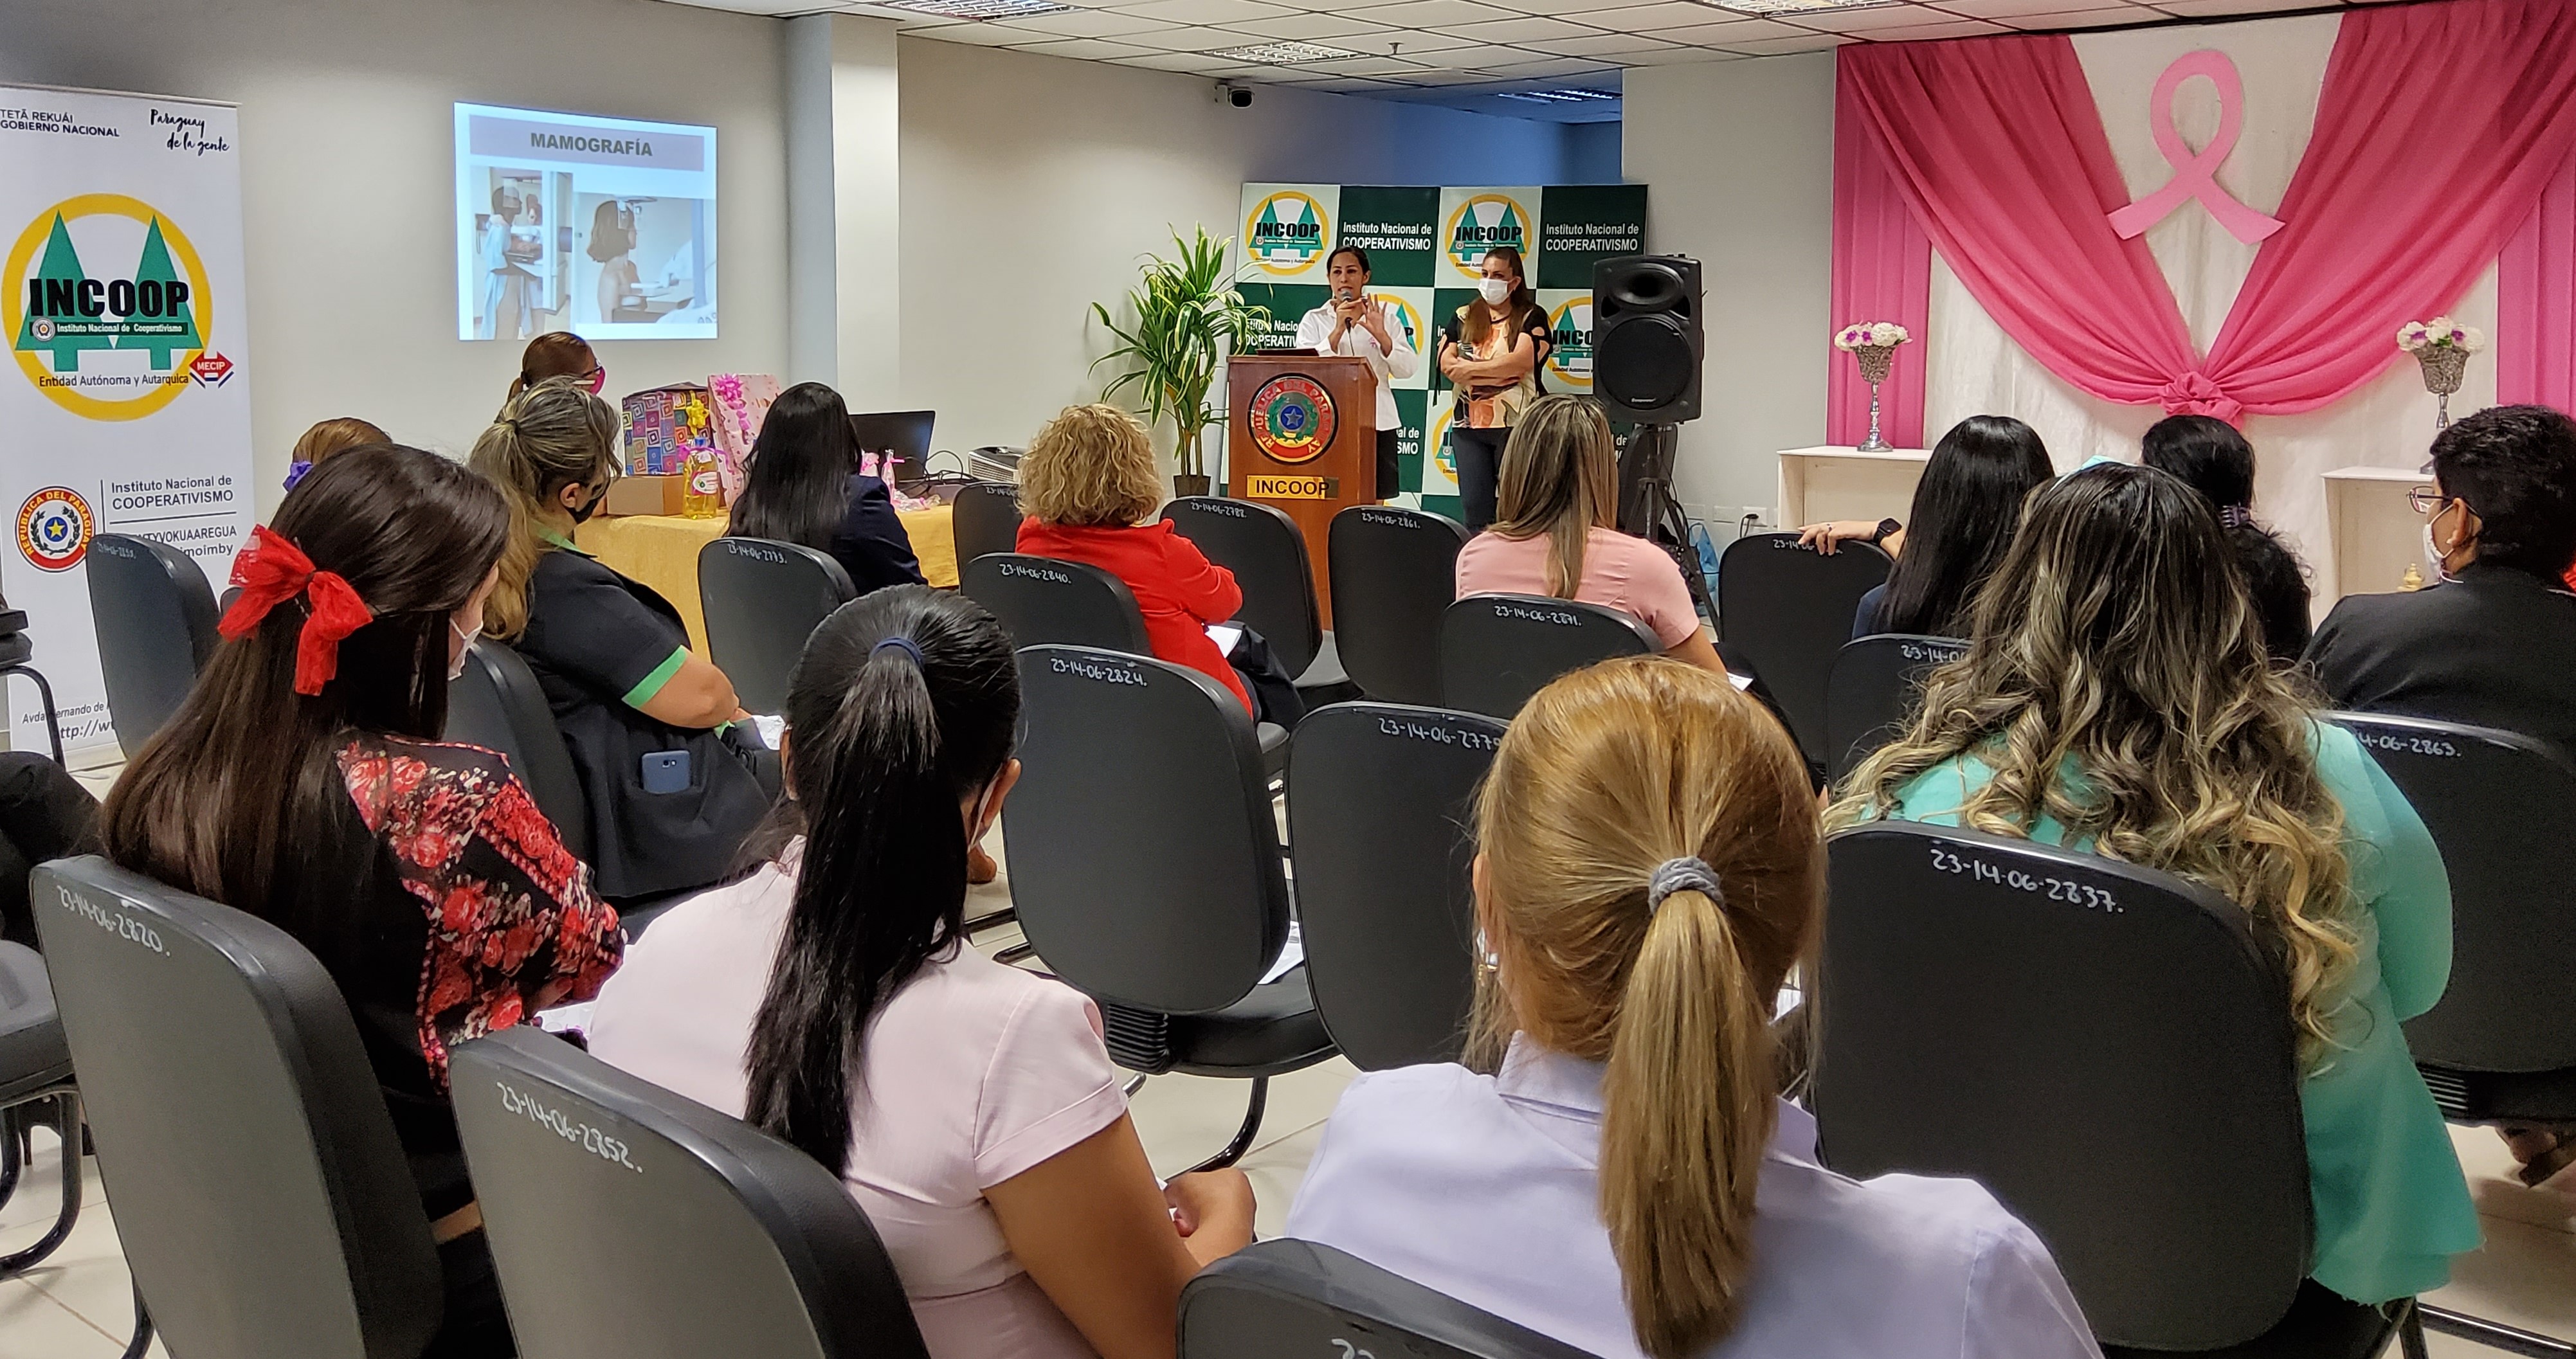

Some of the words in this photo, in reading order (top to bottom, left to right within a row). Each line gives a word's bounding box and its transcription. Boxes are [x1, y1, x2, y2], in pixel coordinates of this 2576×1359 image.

[32, 112, 73, 123] REKUÁI
[150, 109, 204, 139] Paraguay
[0, 120, 59, 132] GOBIERNO
[63, 125, 120, 137] NACIONAL
[167, 132, 181, 150] de
[183, 132, 195, 150] la
[197, 136, 230, 156] gente
[531, 132, 653, 156] MAMOGRAFÍA
[1256, 222, 1320, 237] INCOOP
[1343, 222, 1379, 233] Instituto
[1381, 222, 1419, 234] Nacional
[1421, 223, 1432, 234] de
[1455, 226, 1522, 241] INCOOP
[1546, 223, 1583, 235] Instituto
[1586, 223, 1625, 235] Nacional
[1628, 223, 1639, 234] de
[1343, 237, 1431, 250] COOPERATIVISMO
[1546, 239, 1638, 251] COOPERATIVISMO
[30, 278, 188, 318] INCOOP
[57, 323, 87, 332] Instituto
[88, 323, 119, 332] Nacional
[121, 323, 130, 332] de
[134, 323, 182, 334] Cooperativismo
[1274, 320, 1299, 332] Nacio
[1237, 334, 1297, 347] COOPERATIV
[1552, 330, 1593, 345] INCO
[197, 361, 225, 371] MECIP
[39, 376, 77, 387] Entidad
[80, 374, 131, 386] Autónoma
[134, 376, 140, 388] y
[1408, 427, 1419, 438] de
[111, 481, 162, 493] Instituto
[166, 476, 214, 489] Nacional
[218, 474, 232, 485] de
[1256, 480, 1330, 496] INCOOP
[113, 490, 233, 510] COOPERATIVISMO
[46, 491, 66, 500] DEL
[68, 495, 91, 551] PARAGUAY
[180, 543, 234, 557] moimby
[56, 704, 91, 718] ernando
[94, 701, 104, 712] de
[60, 719, 112, 740] ttp://w
[2358, 732, 2462, 757] 4-06-2863.
